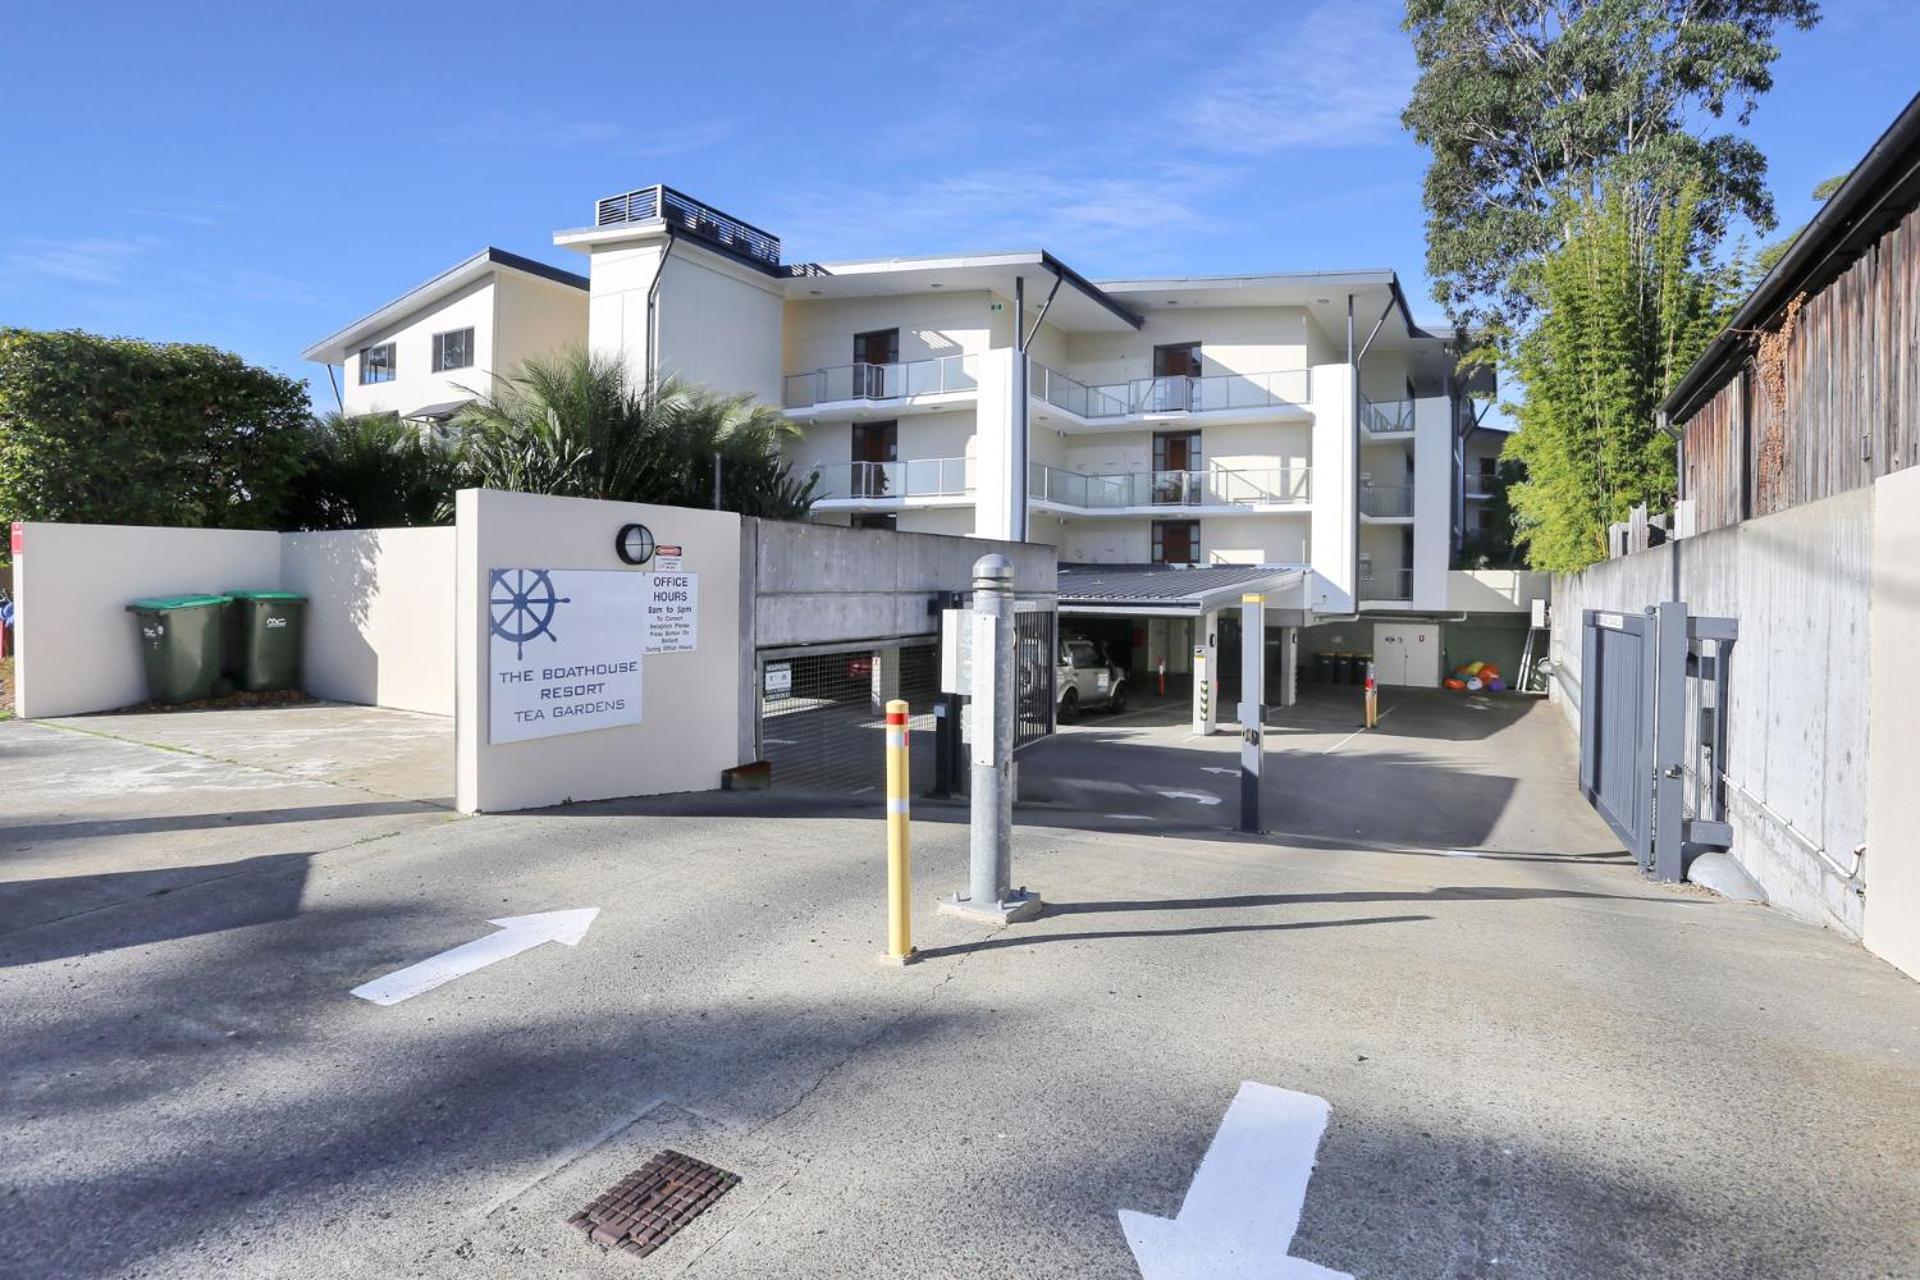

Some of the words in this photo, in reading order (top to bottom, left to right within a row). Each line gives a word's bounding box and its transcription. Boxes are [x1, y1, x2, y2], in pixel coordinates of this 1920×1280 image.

[653, 576, 688, 587] OFFICE
[653, 591, 688, 602] HOURS
[499, 670, 534, 683] THE
[542, 661, 638, 680] BOATHOUSE
[540, 683, 606, 700] RESORT
[514, 709, 545, 723] TEA
[552, 699, 626, 718] GARDENS
